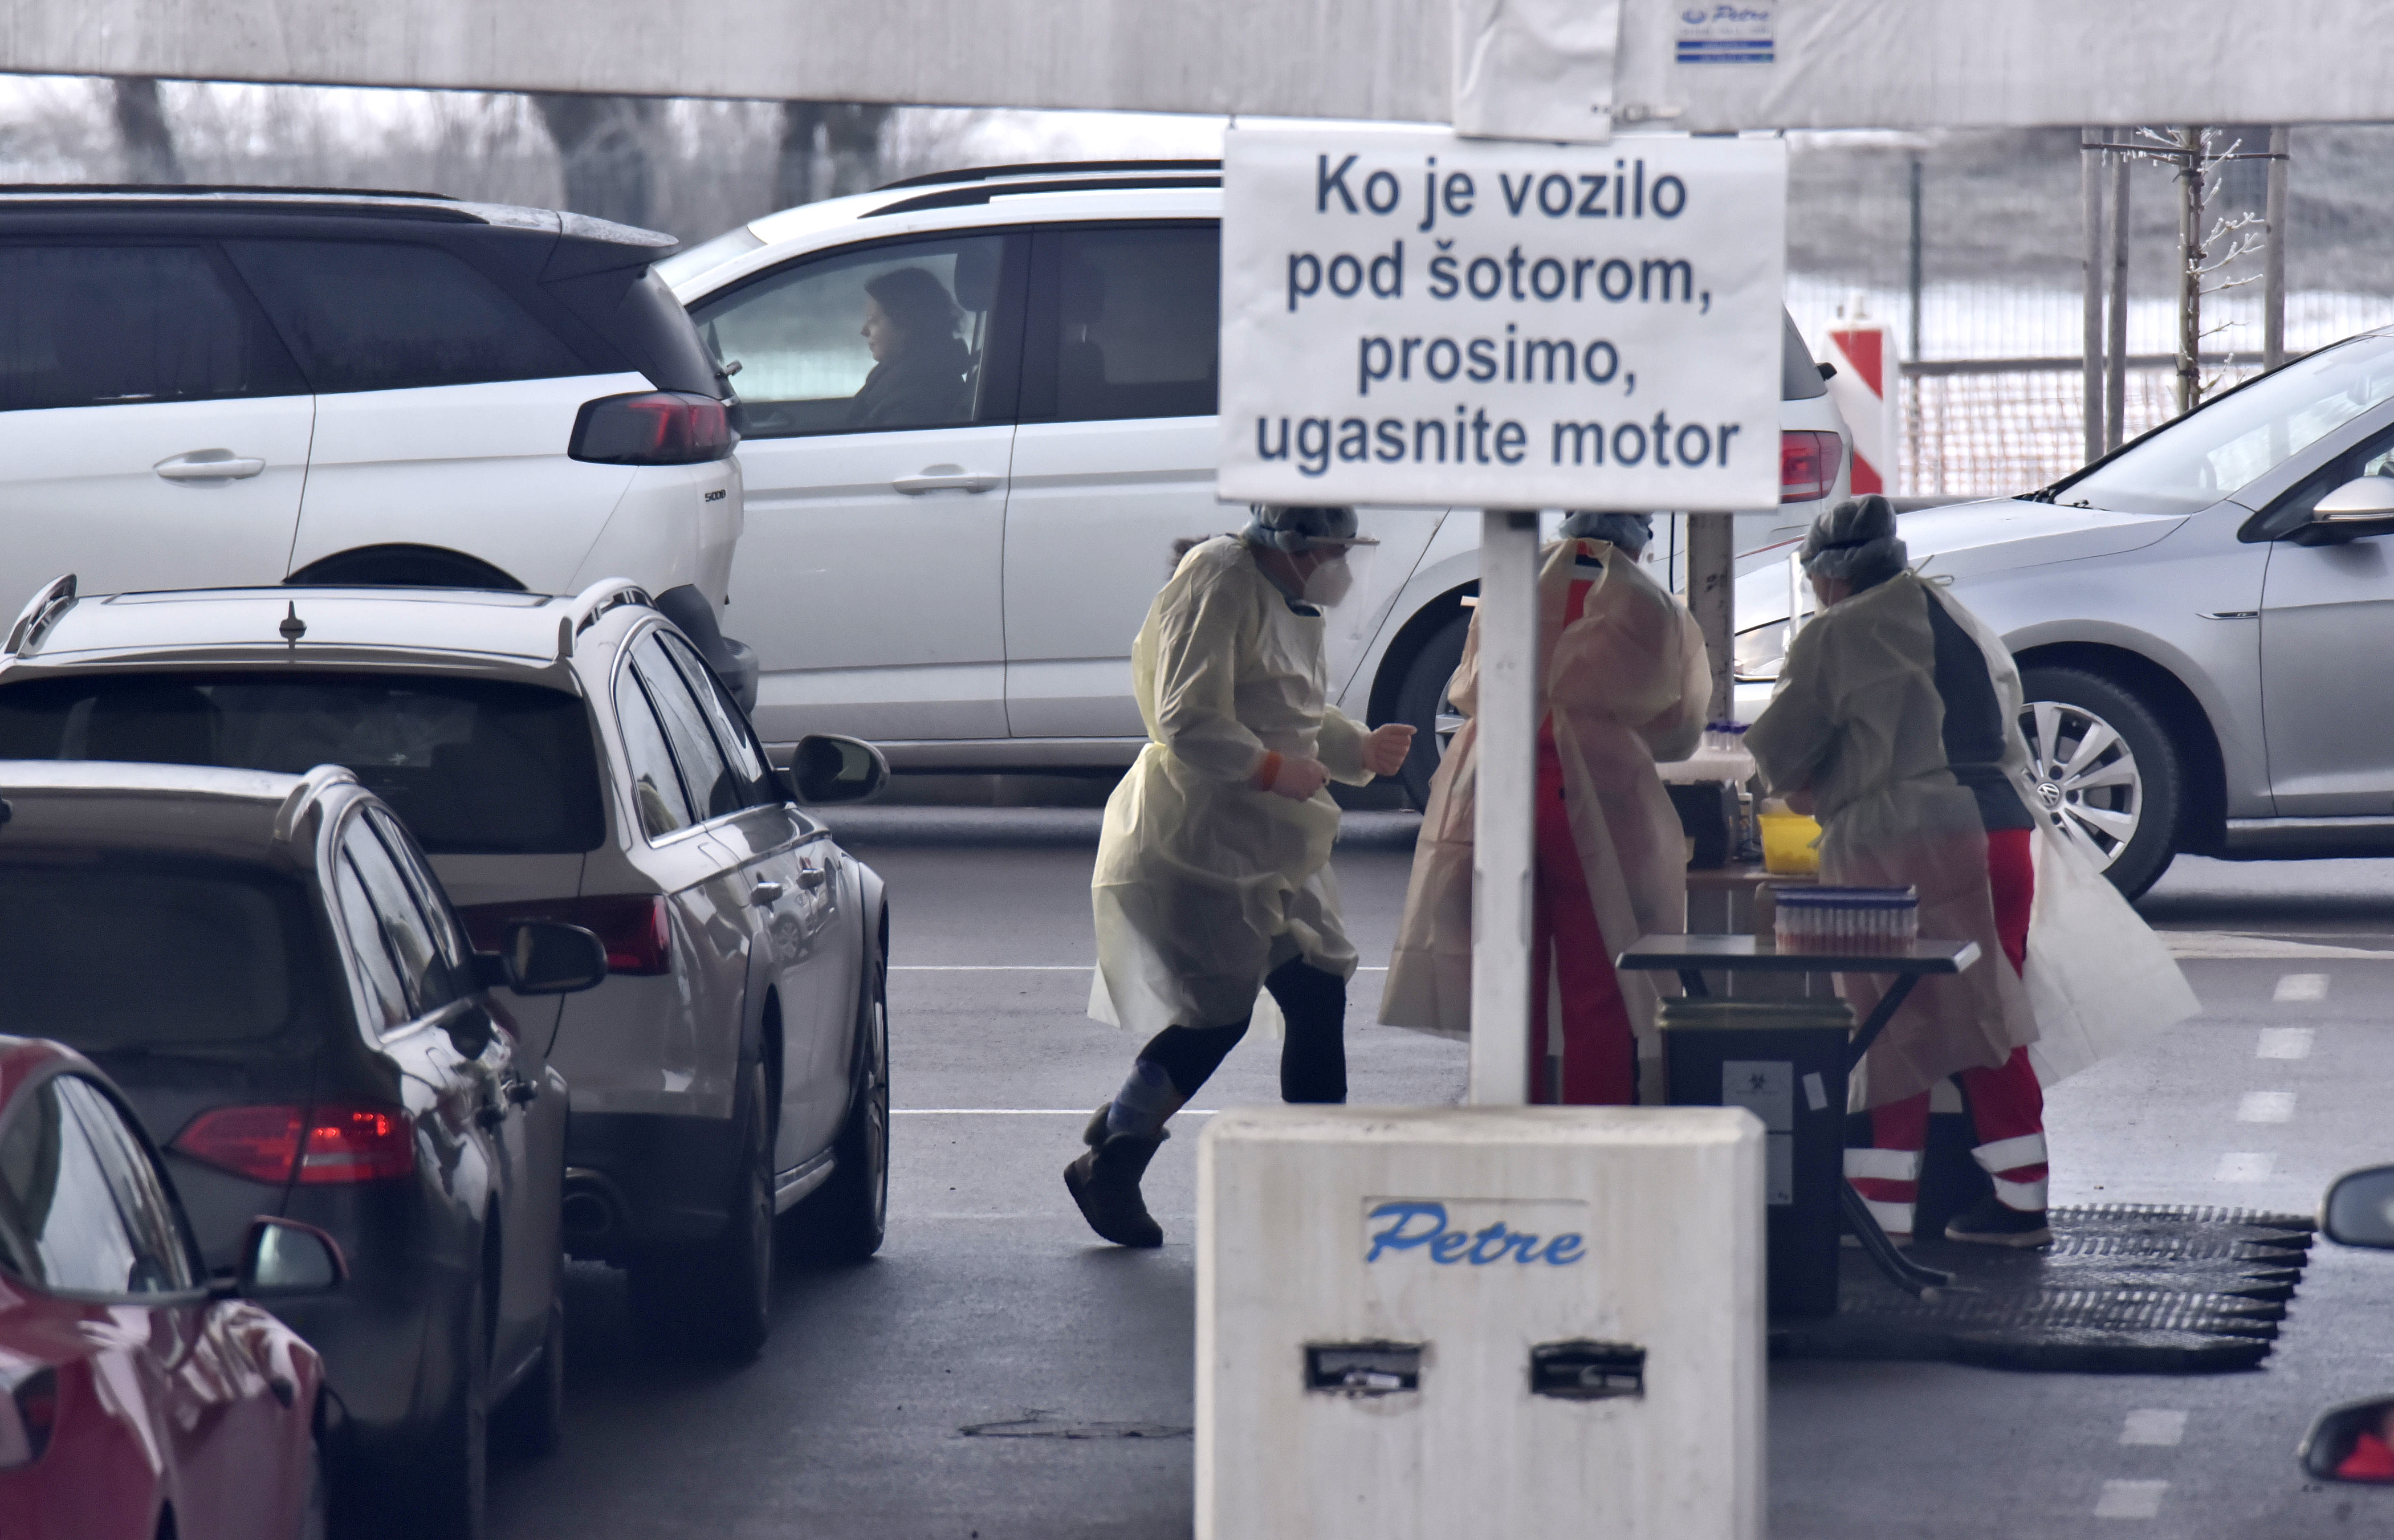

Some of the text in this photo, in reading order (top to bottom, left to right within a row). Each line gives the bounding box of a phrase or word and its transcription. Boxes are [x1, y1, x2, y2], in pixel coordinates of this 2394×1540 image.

[1316, 154, 1687, 233] Ko je vozilo
[1287, 238, 1711, 314] pod šotorom,
[1358, 323, 1636, 397] prosimo,
[1256, 404, 1741, 476] ugasnite motor
[1366, 1201, 1586, 1265] Petre
